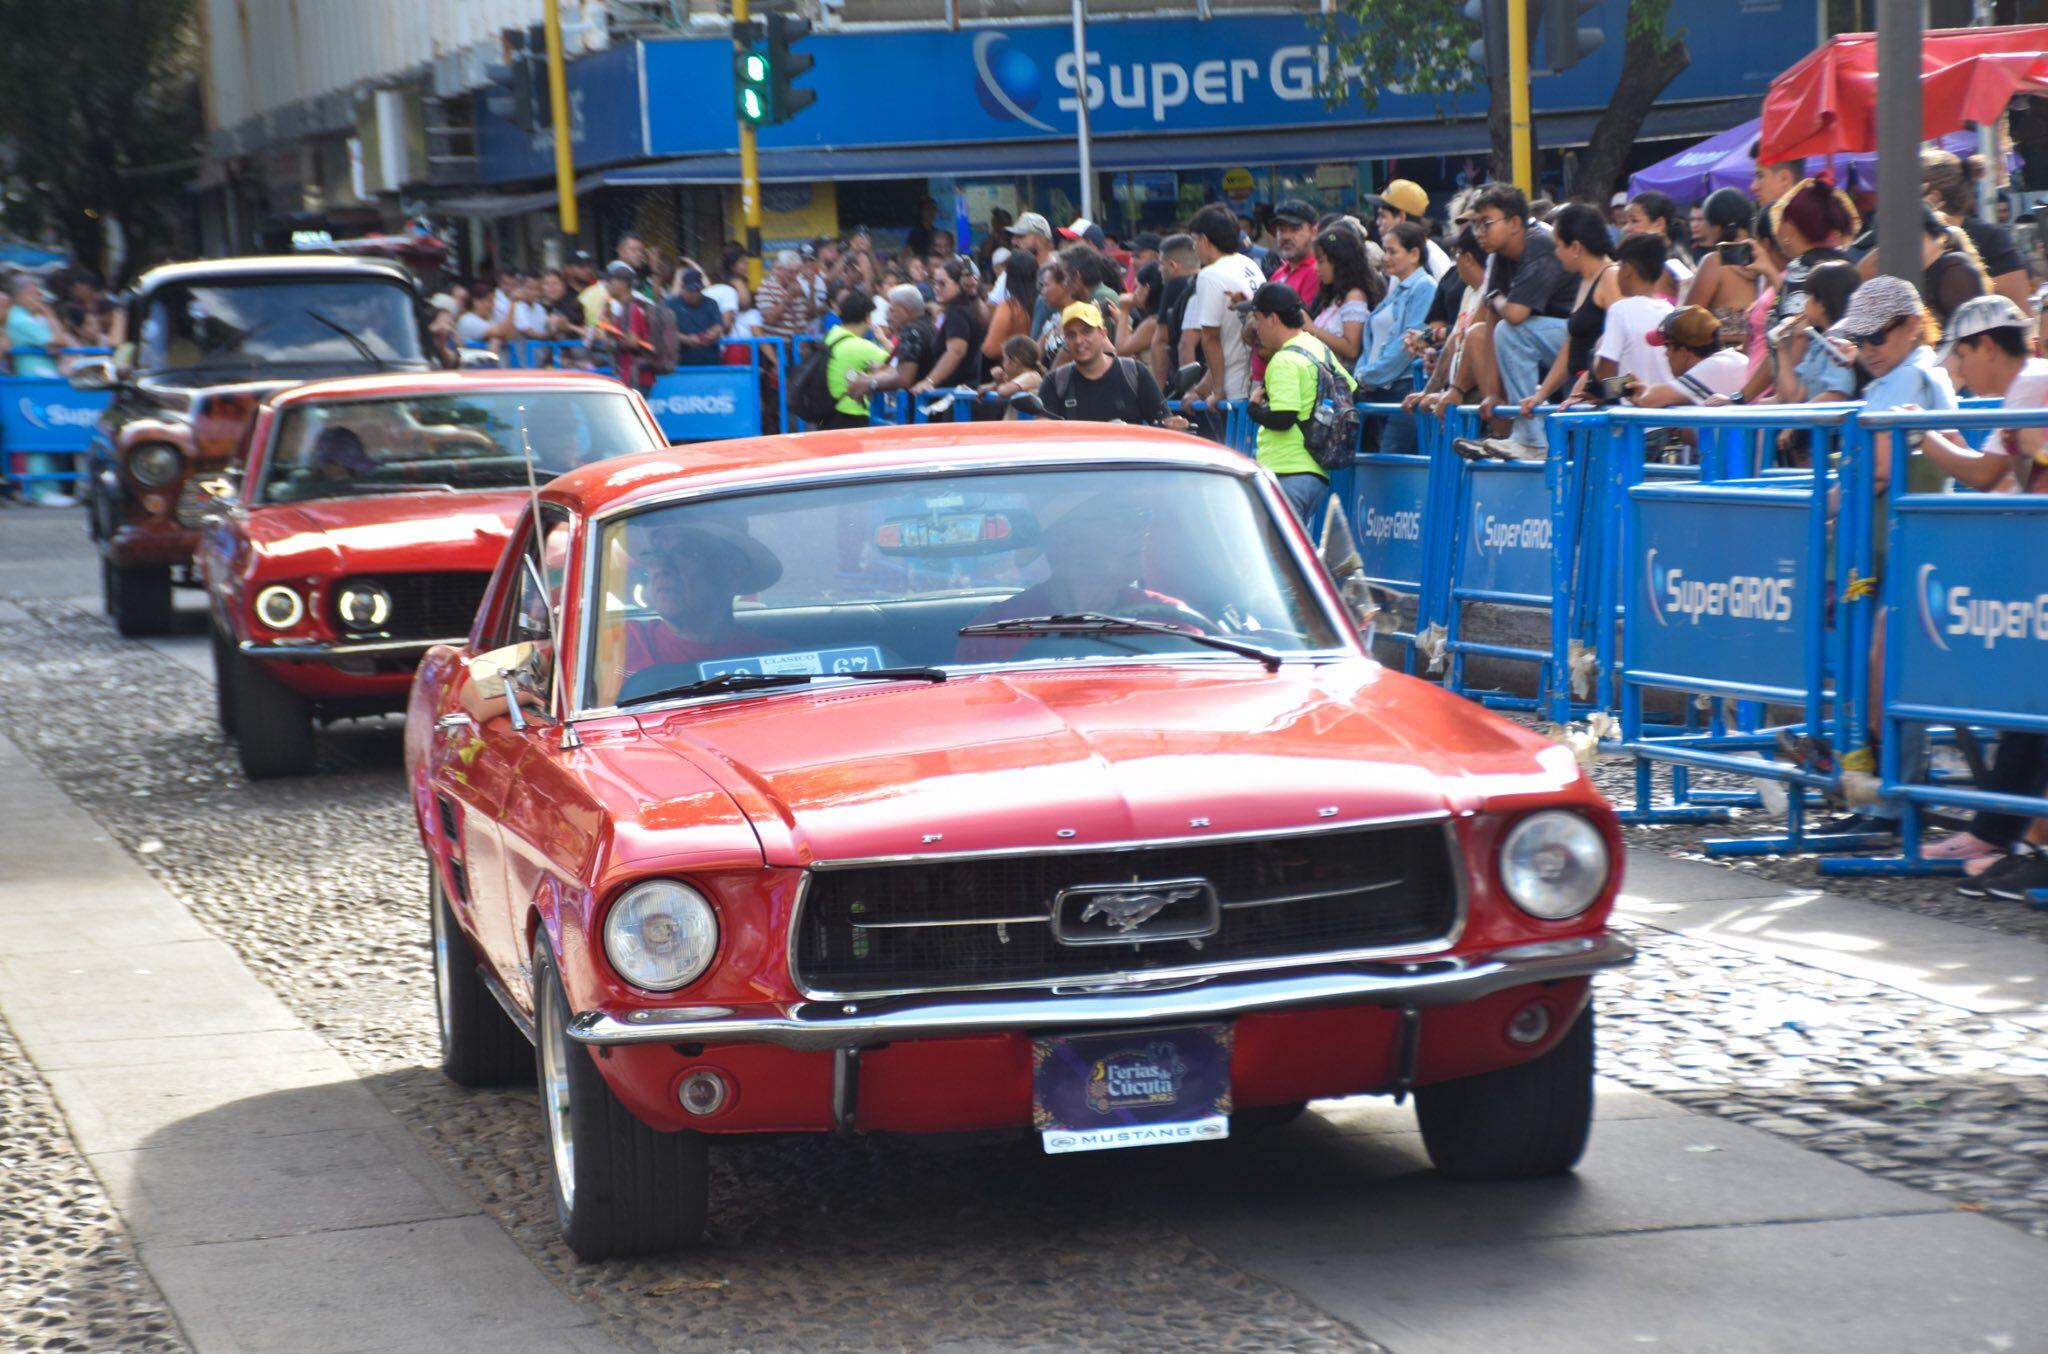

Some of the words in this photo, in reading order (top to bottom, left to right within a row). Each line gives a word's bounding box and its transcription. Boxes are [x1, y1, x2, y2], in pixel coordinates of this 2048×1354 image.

[832, 655, 868, 674] 67
[921, 806, 1339, 844] FORD
[1107, 1063, 1159, 1080] Ferias
[1081, 1127, 1191, 1145] MUSTANG
